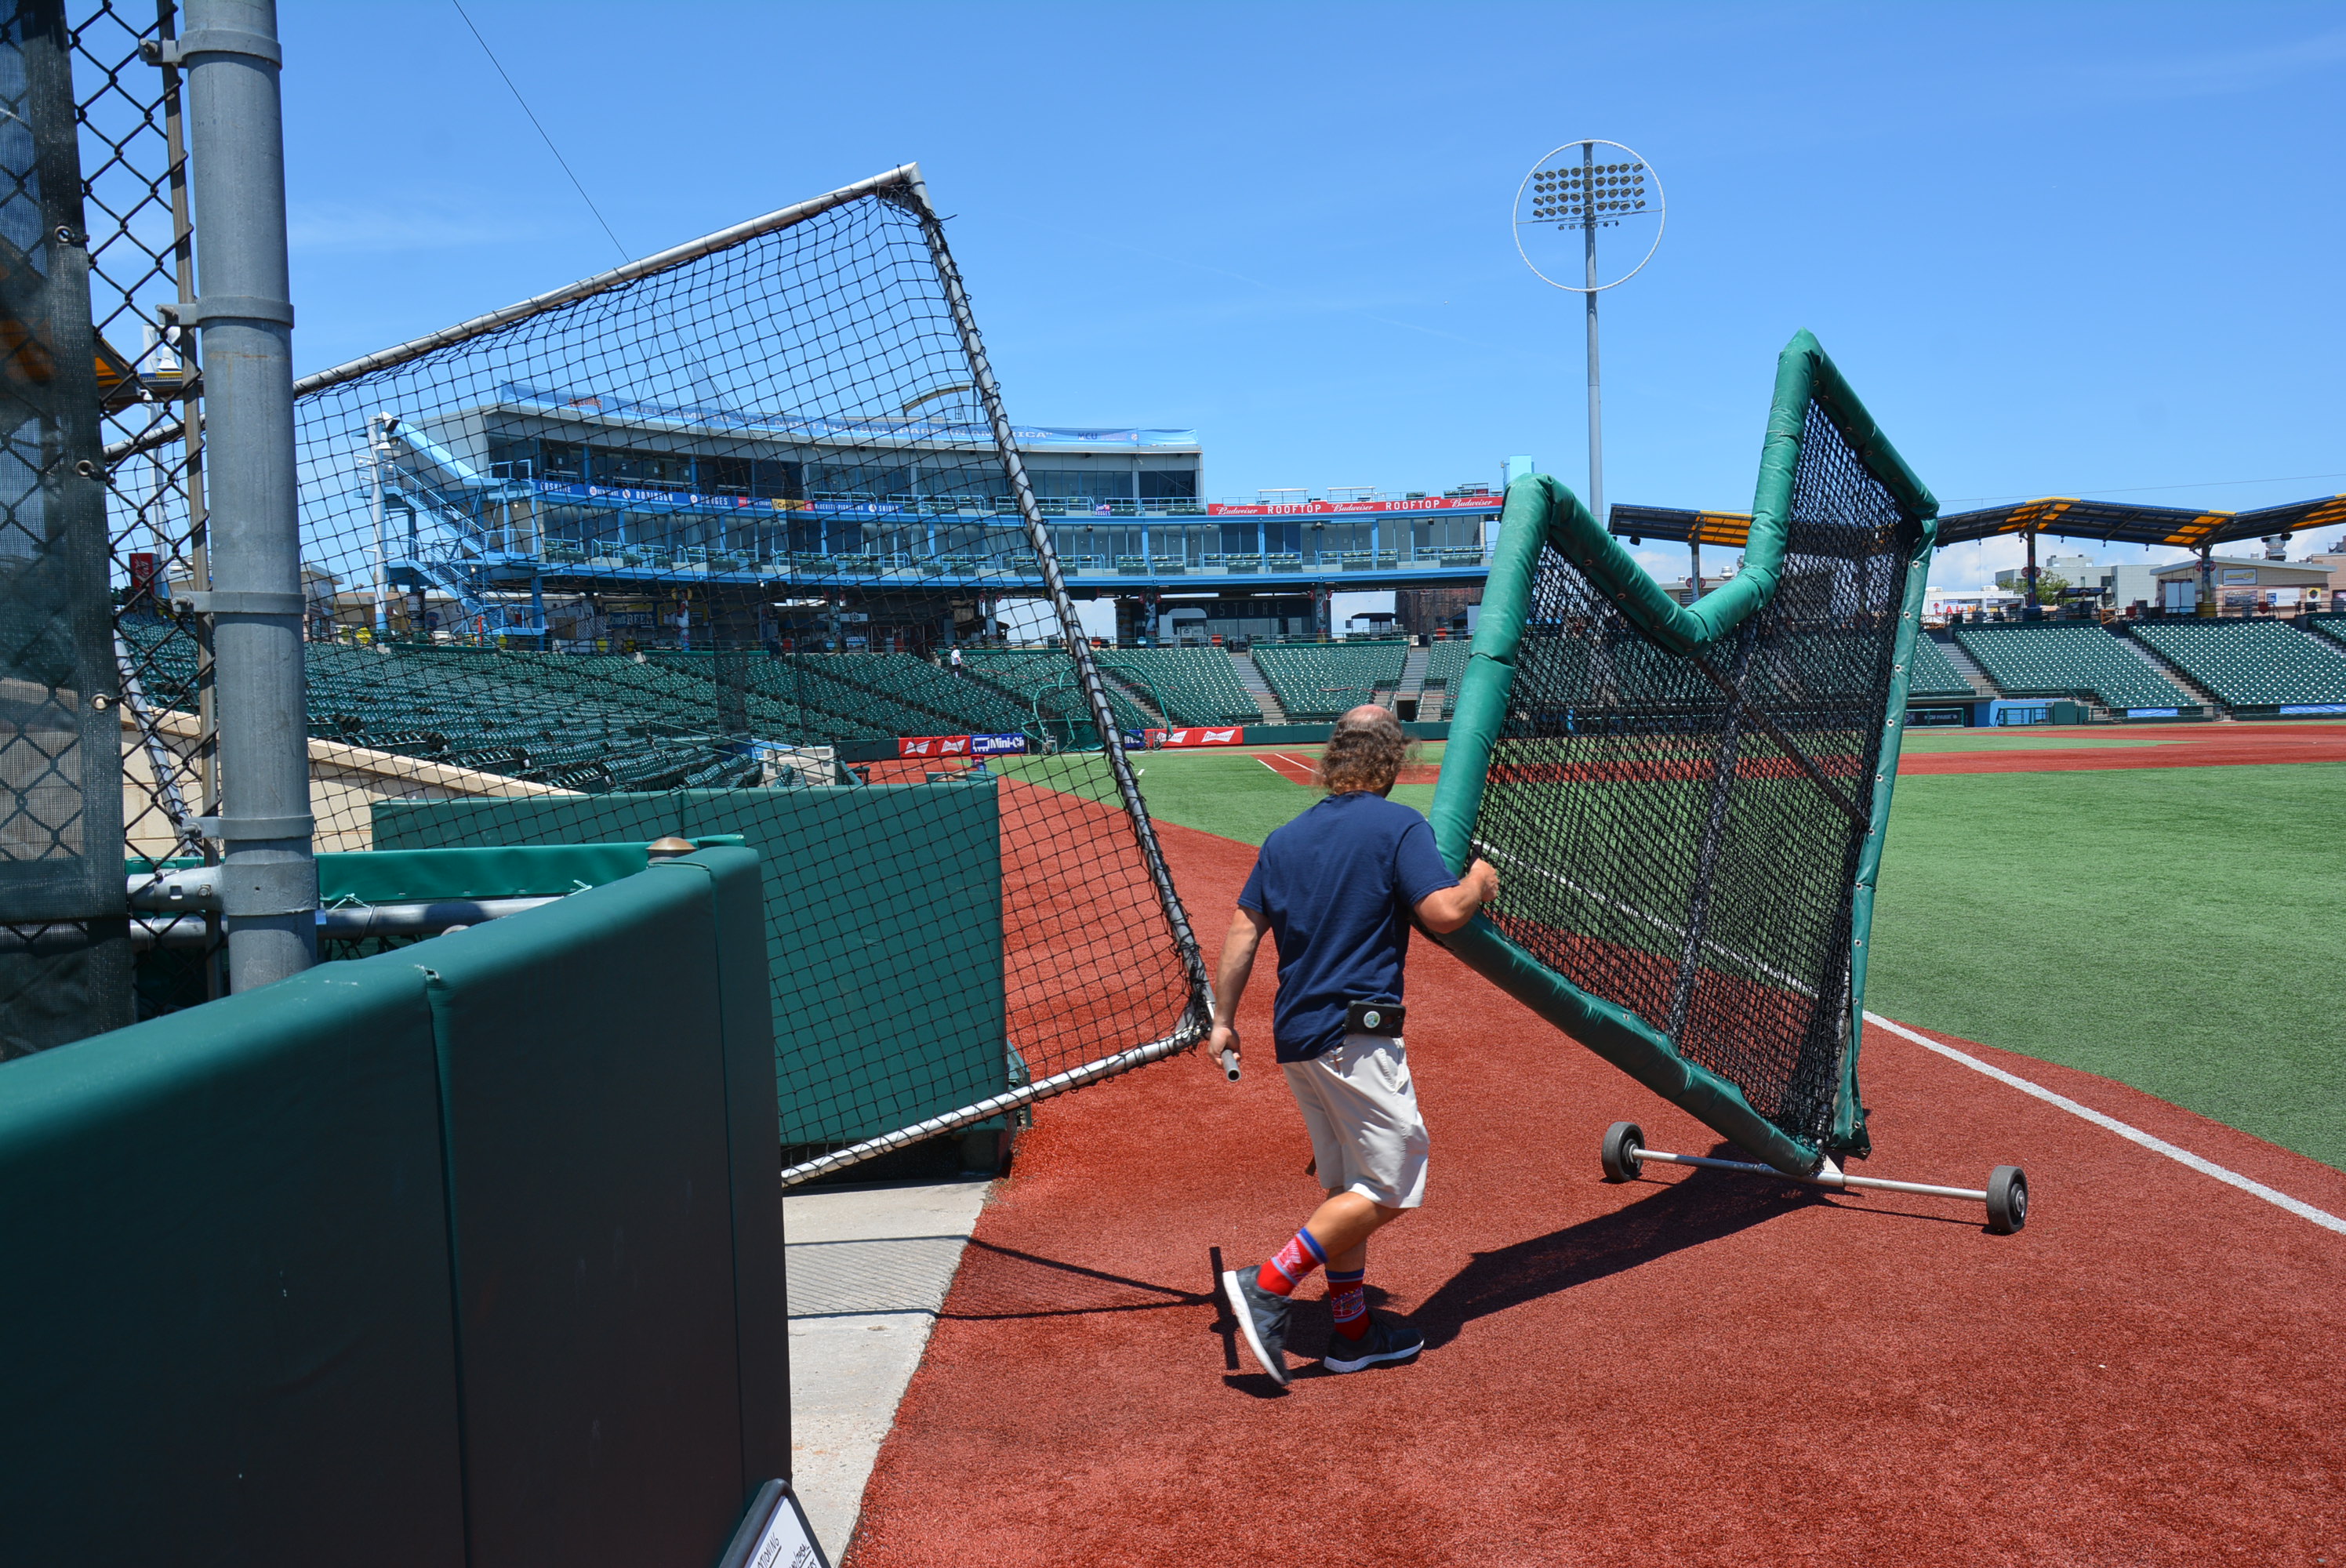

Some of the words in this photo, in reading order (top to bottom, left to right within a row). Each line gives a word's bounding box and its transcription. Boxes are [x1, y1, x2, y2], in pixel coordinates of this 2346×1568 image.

[636, 491, 674, 502] ROBINSON
[878, 504, 899, 513] SNIDR
[1216, 506, 1258, 516] Budweiser
[1267, 504, 1322, 515] ROOFTOP
[1331, 503, 1374, 514] Budweiser
[1385, 499, 1440, 511] ROOFTOP
[1450, 497, 1493, 508] Budweiser
[1219, 602, 1283, 616] STORE
